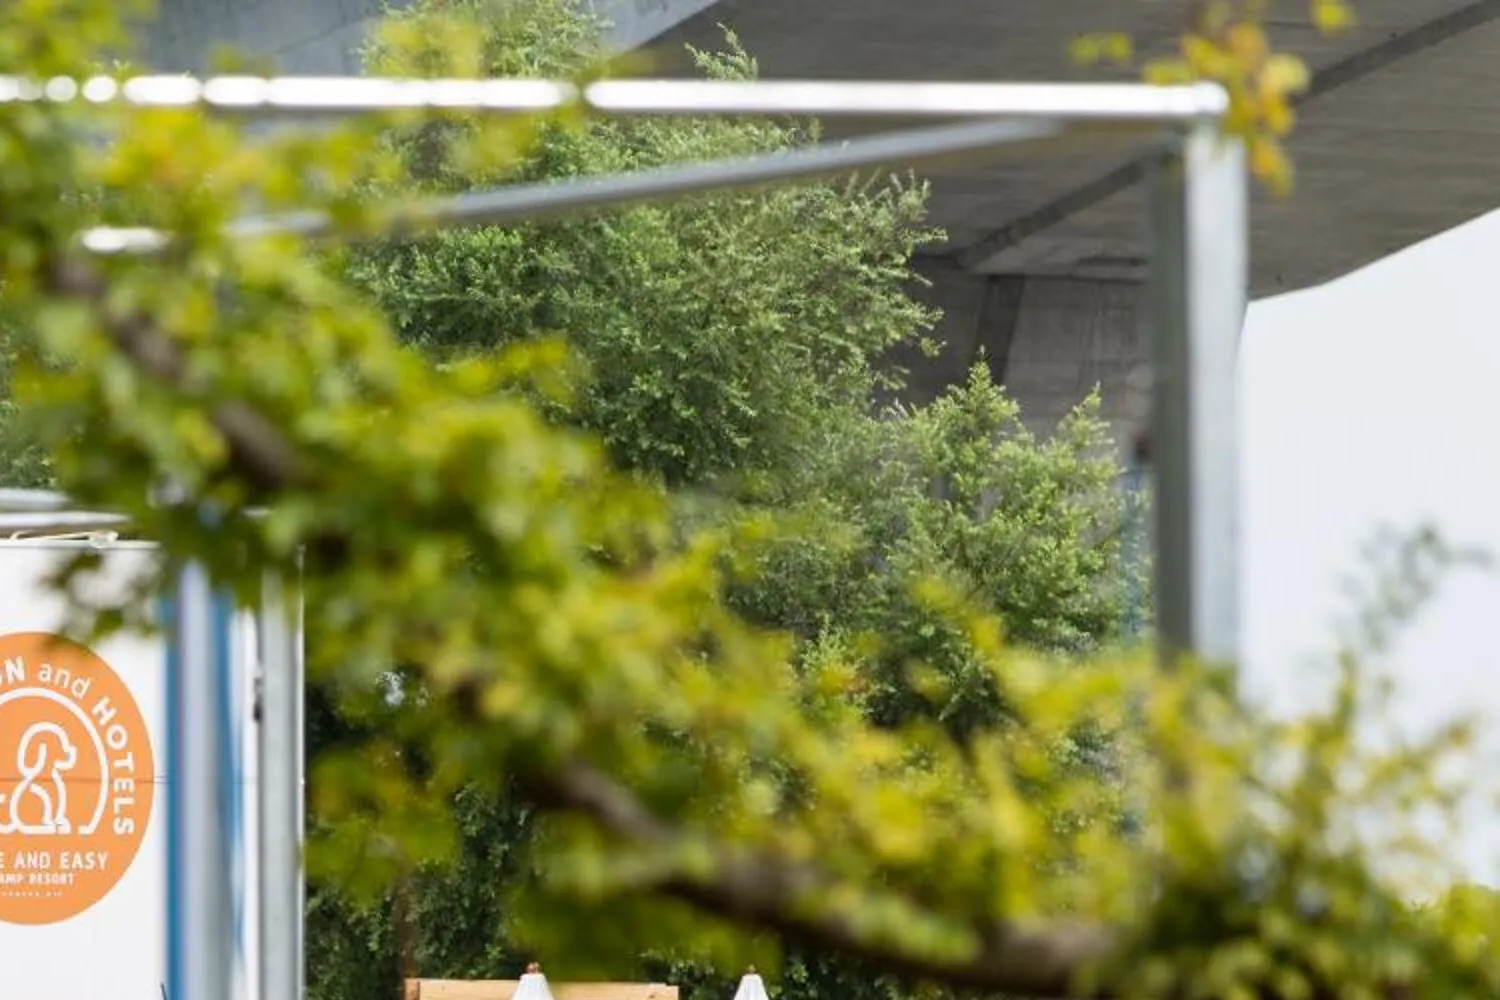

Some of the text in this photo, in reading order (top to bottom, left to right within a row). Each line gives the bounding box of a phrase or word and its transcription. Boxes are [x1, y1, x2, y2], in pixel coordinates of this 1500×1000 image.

[39, 663, 90, 699] and
[92, 697, 135, 836] HOTELS
[14, 851, 50, 869] AND
[60, 851, 108, 869] EASY
